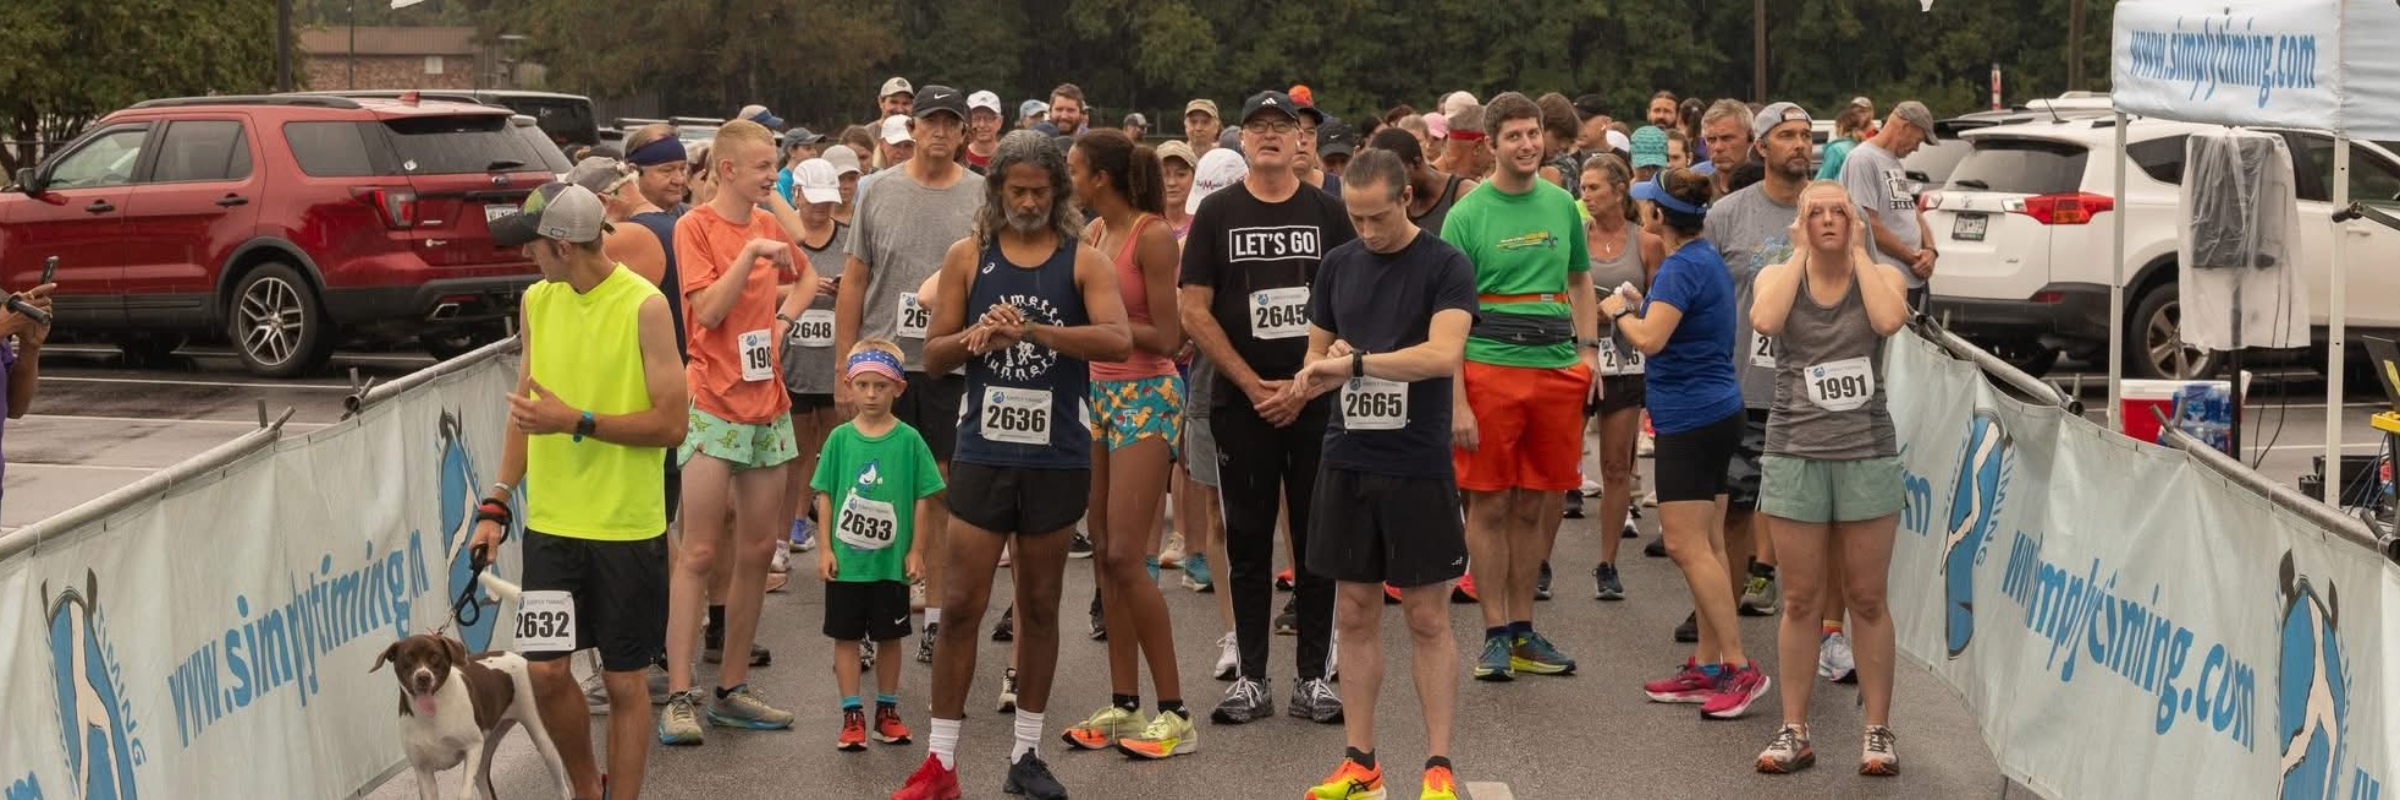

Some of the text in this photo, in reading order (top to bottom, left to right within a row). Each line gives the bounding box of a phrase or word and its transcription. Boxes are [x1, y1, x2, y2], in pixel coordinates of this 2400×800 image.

[2130, 16, 2316, 108] www.simplytiming.com
[1235, 231, 1316, 256] LET'S GO
[1256, 304, 1307, 329] 2645
[791, 321, 832, 339] 2648
[1815, 374, 1867, 400] 1991
[1345, 392, 1402, 417] 2665
[986, 405, 1046, 432] 2636
[841, 509, 893, 541] 2633
[515, 610, 570, 638] 2632
